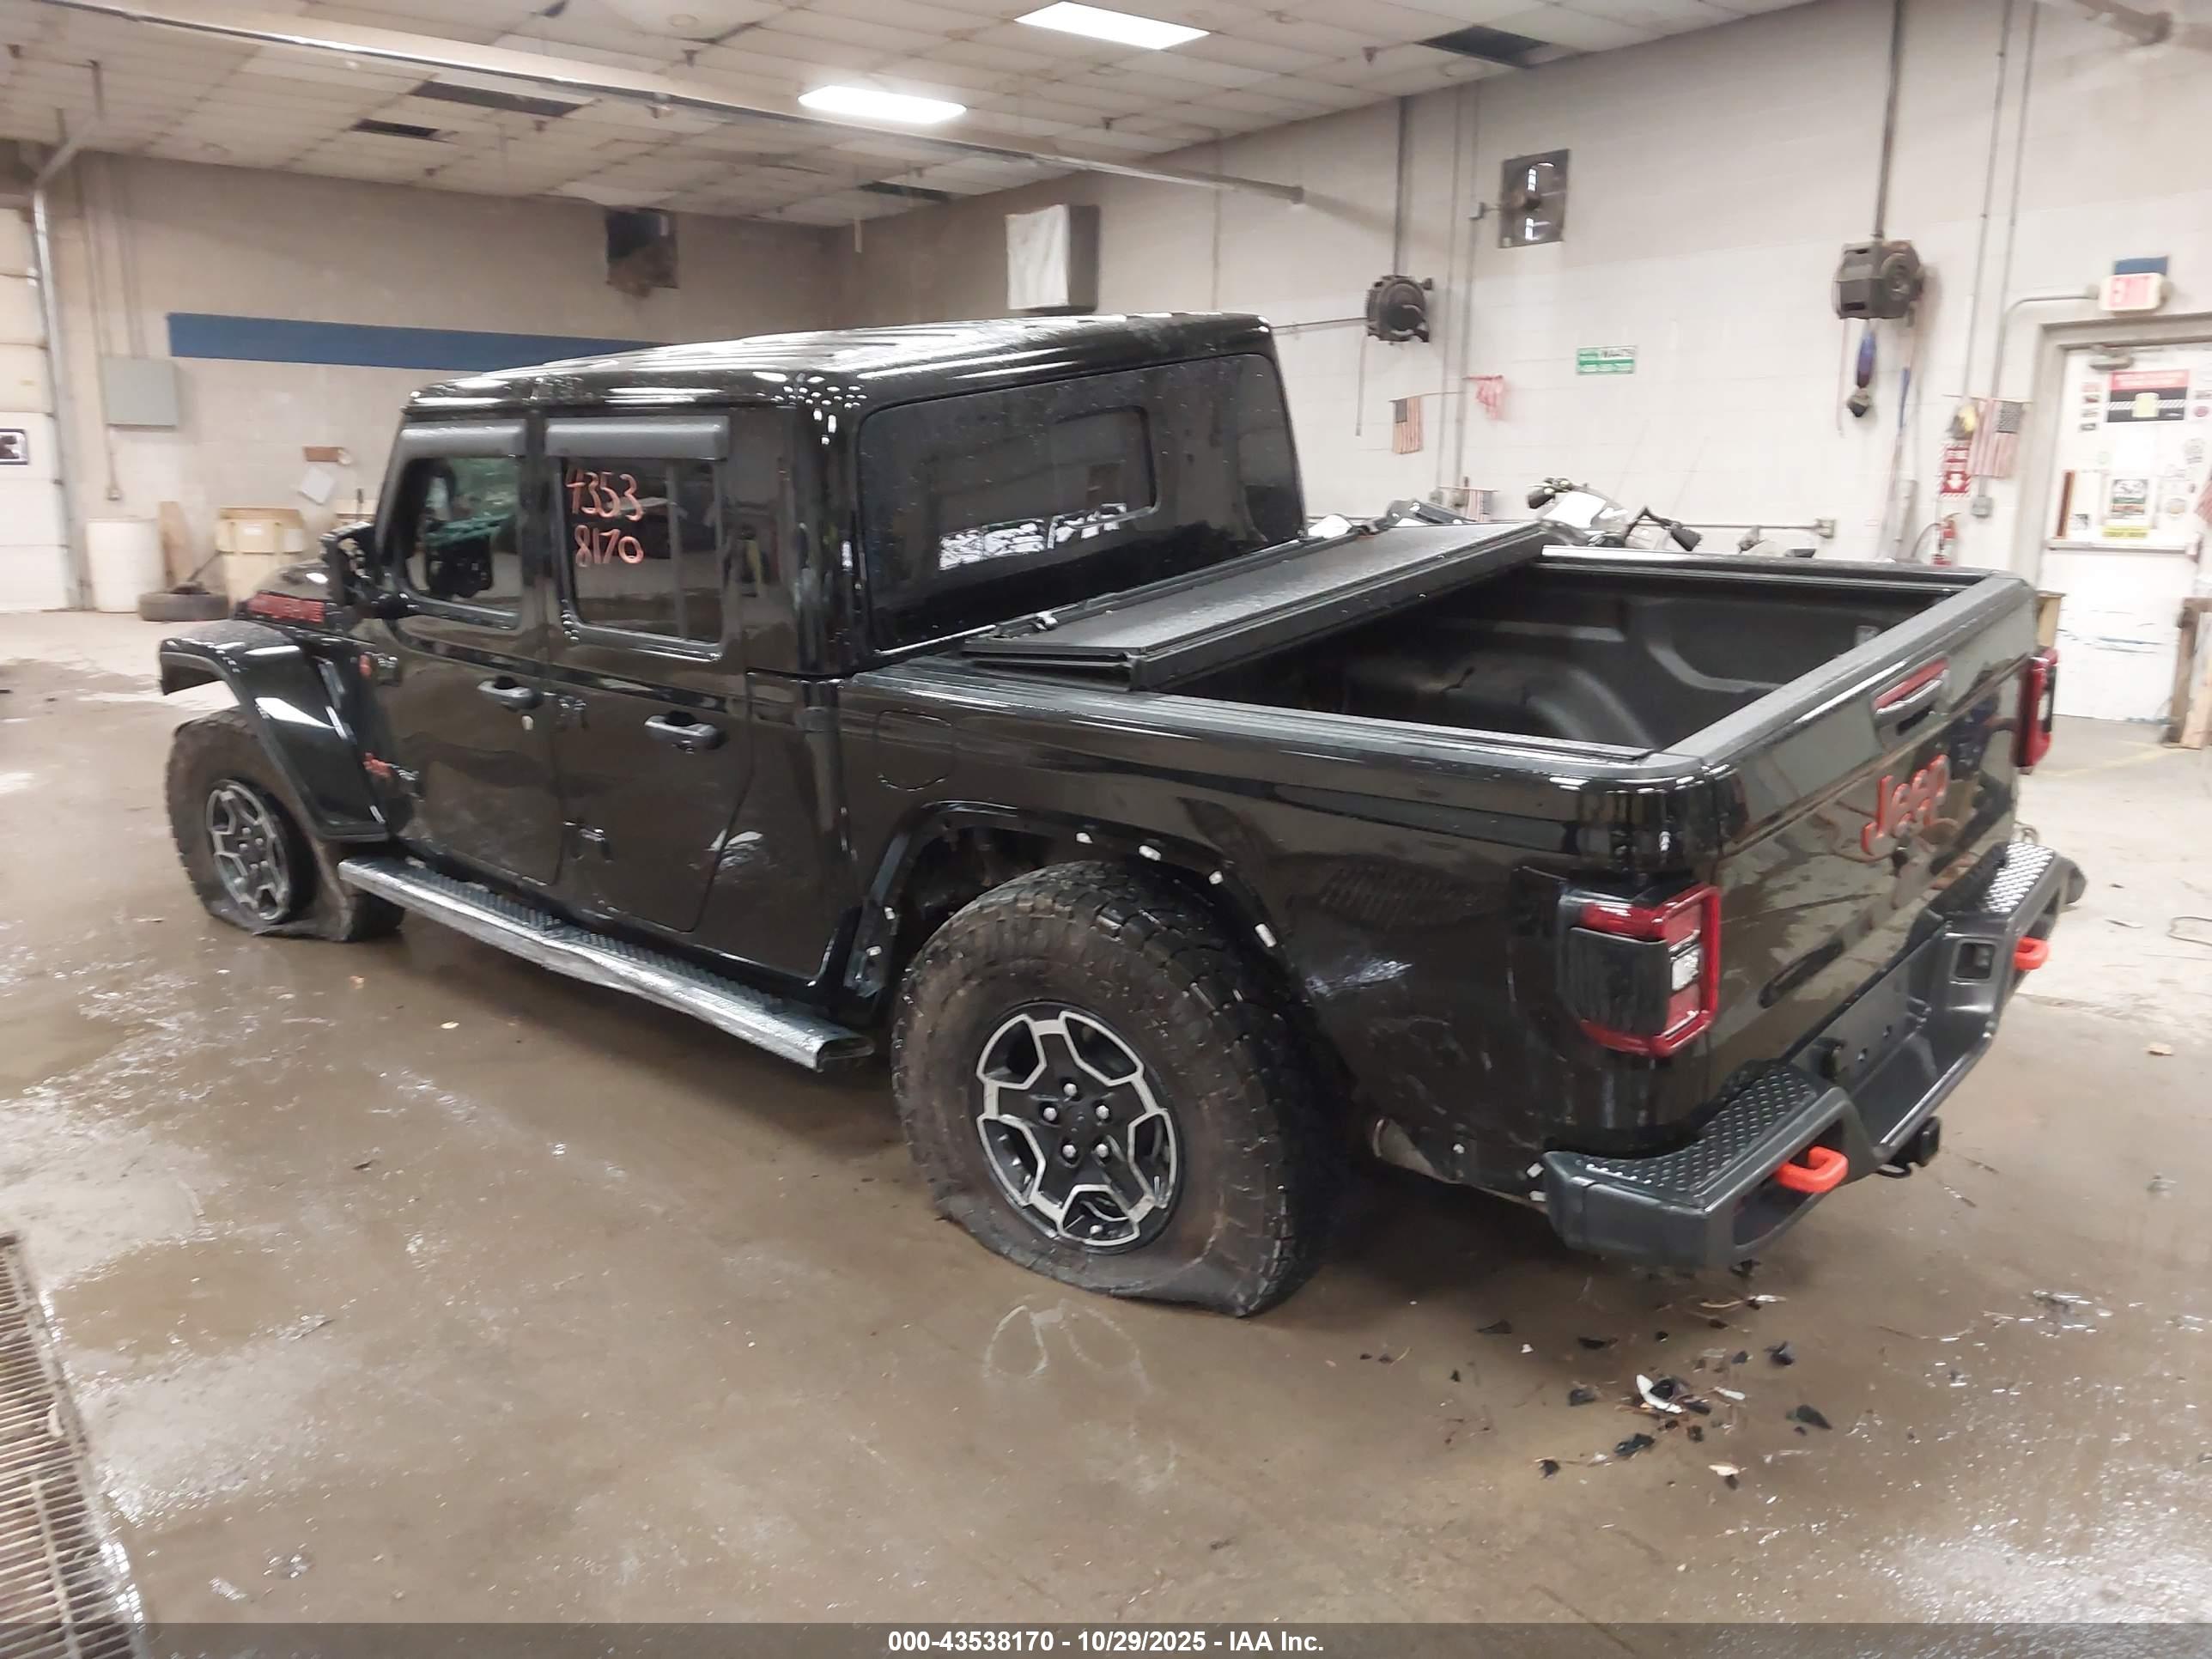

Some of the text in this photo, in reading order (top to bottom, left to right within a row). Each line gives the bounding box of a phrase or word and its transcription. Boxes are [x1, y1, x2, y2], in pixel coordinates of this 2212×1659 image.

[565, 467, 644, 521] 4353
[574, 524, 645, 568] 8170
[1860, 754, 1951, 856] Jeep
